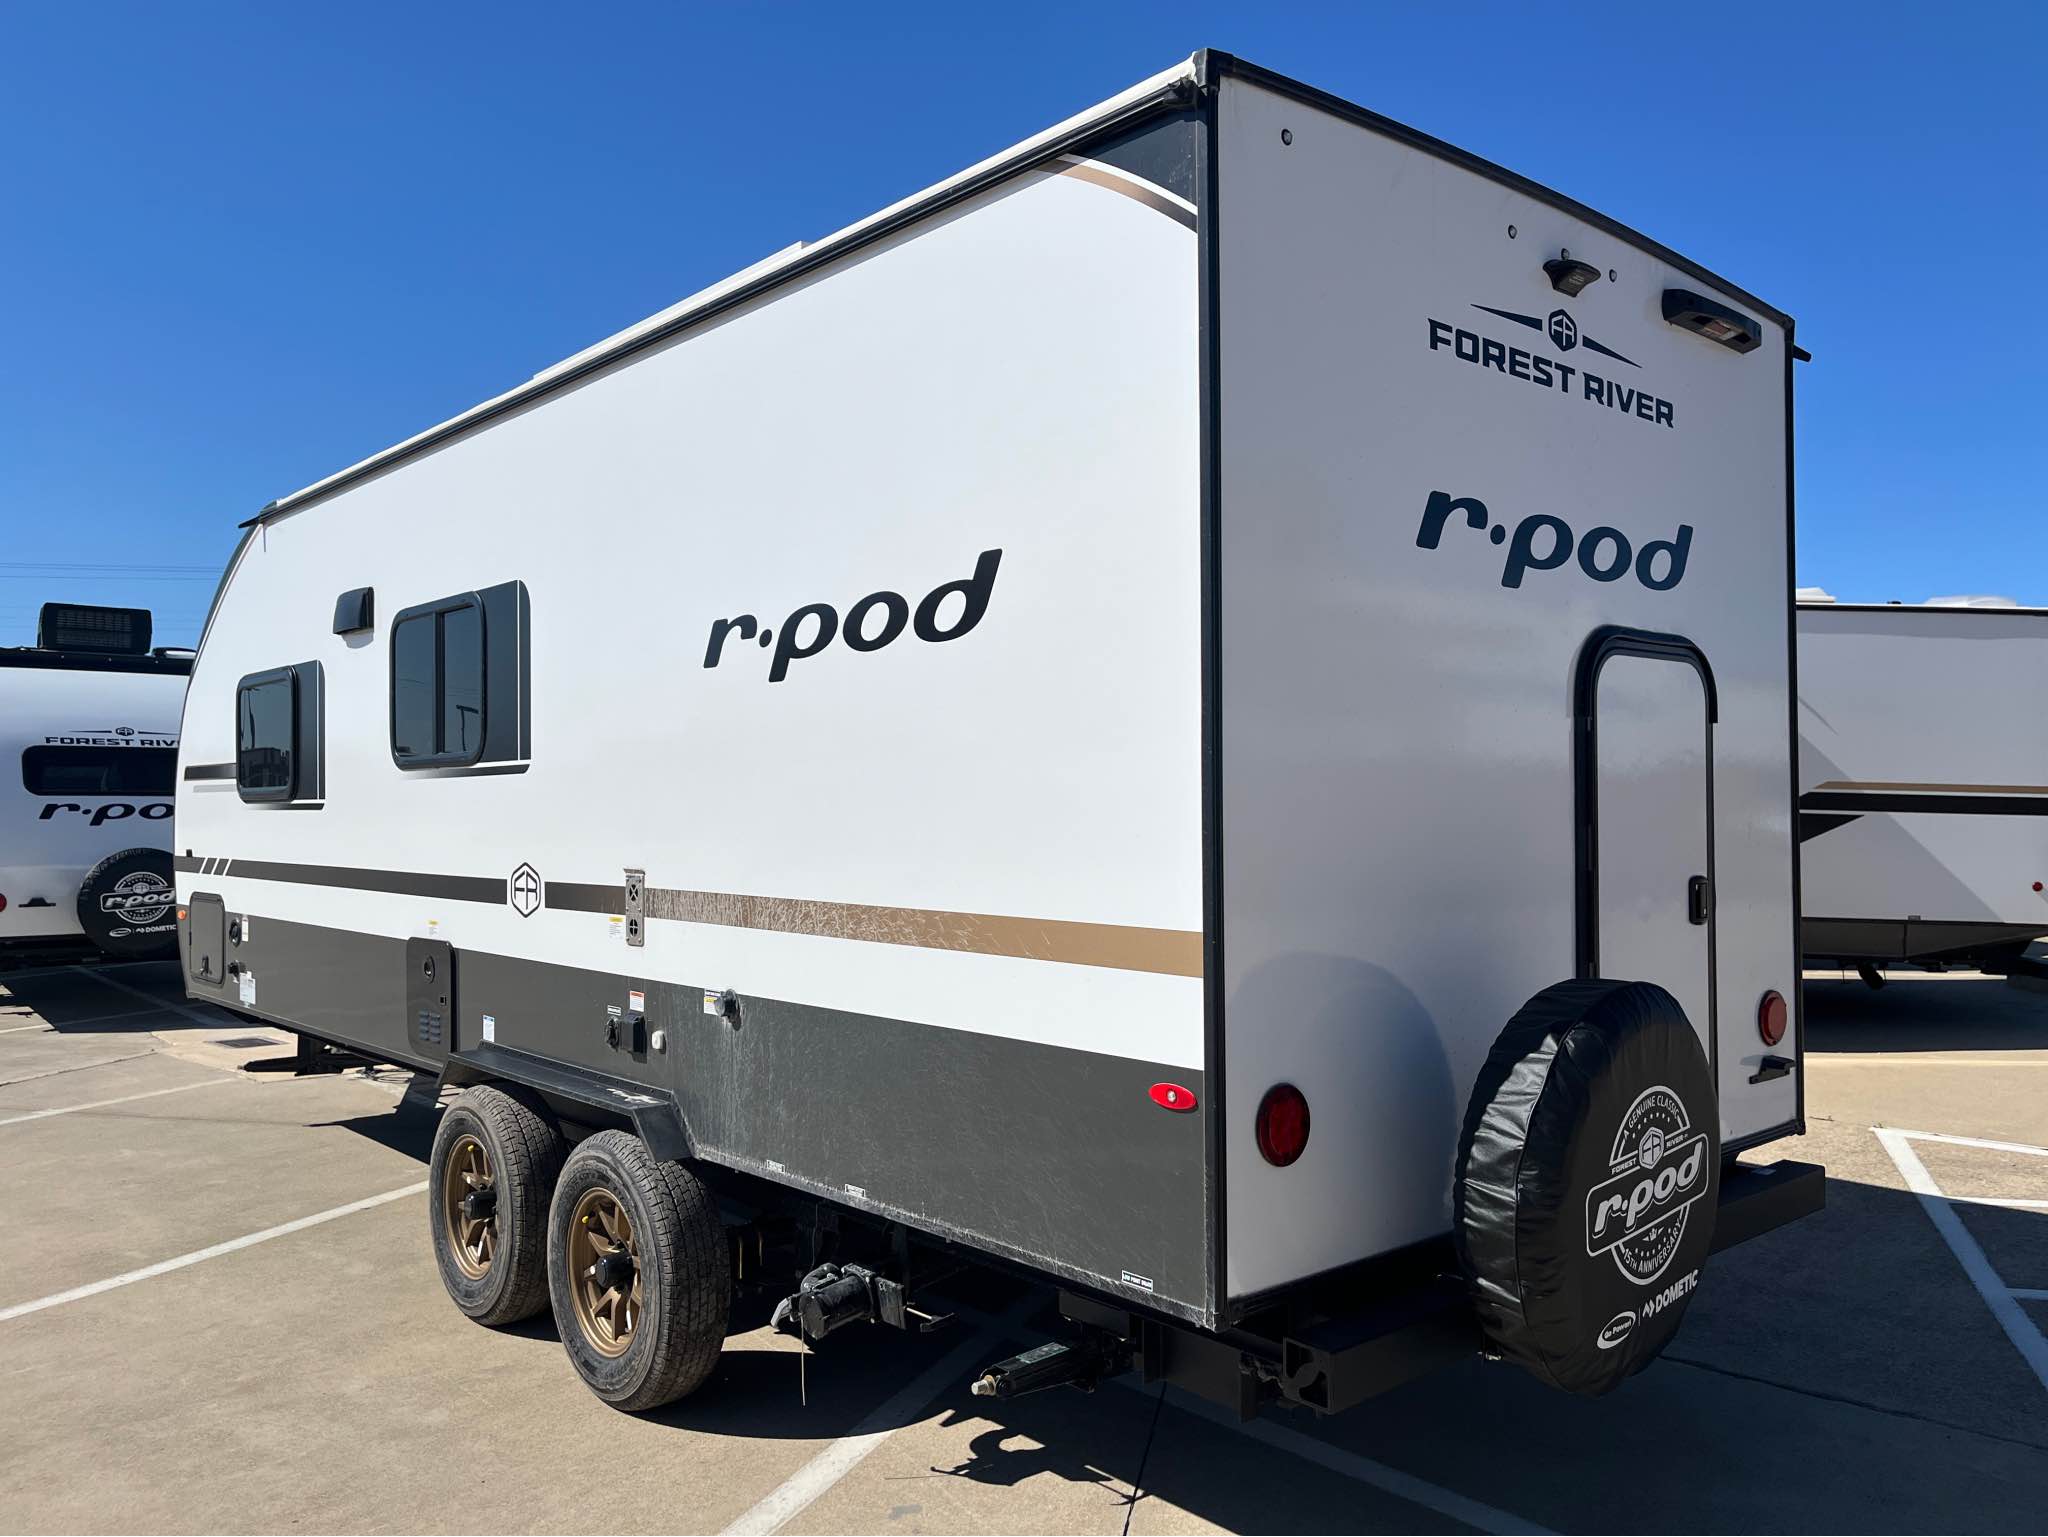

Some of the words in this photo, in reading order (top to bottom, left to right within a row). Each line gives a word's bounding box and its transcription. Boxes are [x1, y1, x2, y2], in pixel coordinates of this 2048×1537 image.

[1427, 317, 1576, 394] FOREST
[1583, 371, 1675, 429] RIVER
[44, 736, 135, 746] FOREST
[140, 739, 179, 747] RIV
[1628, 1095, 1656, 1129] GENUINE
[1656, 1095, 1680, 1119] CLASSIC
[1611, 1157, 1637, 1175] FOREST
[1638, 1216, 1682, 1273] ANNIVERSARY
[1655, 1269, 1699, 1313] DOMETIC
